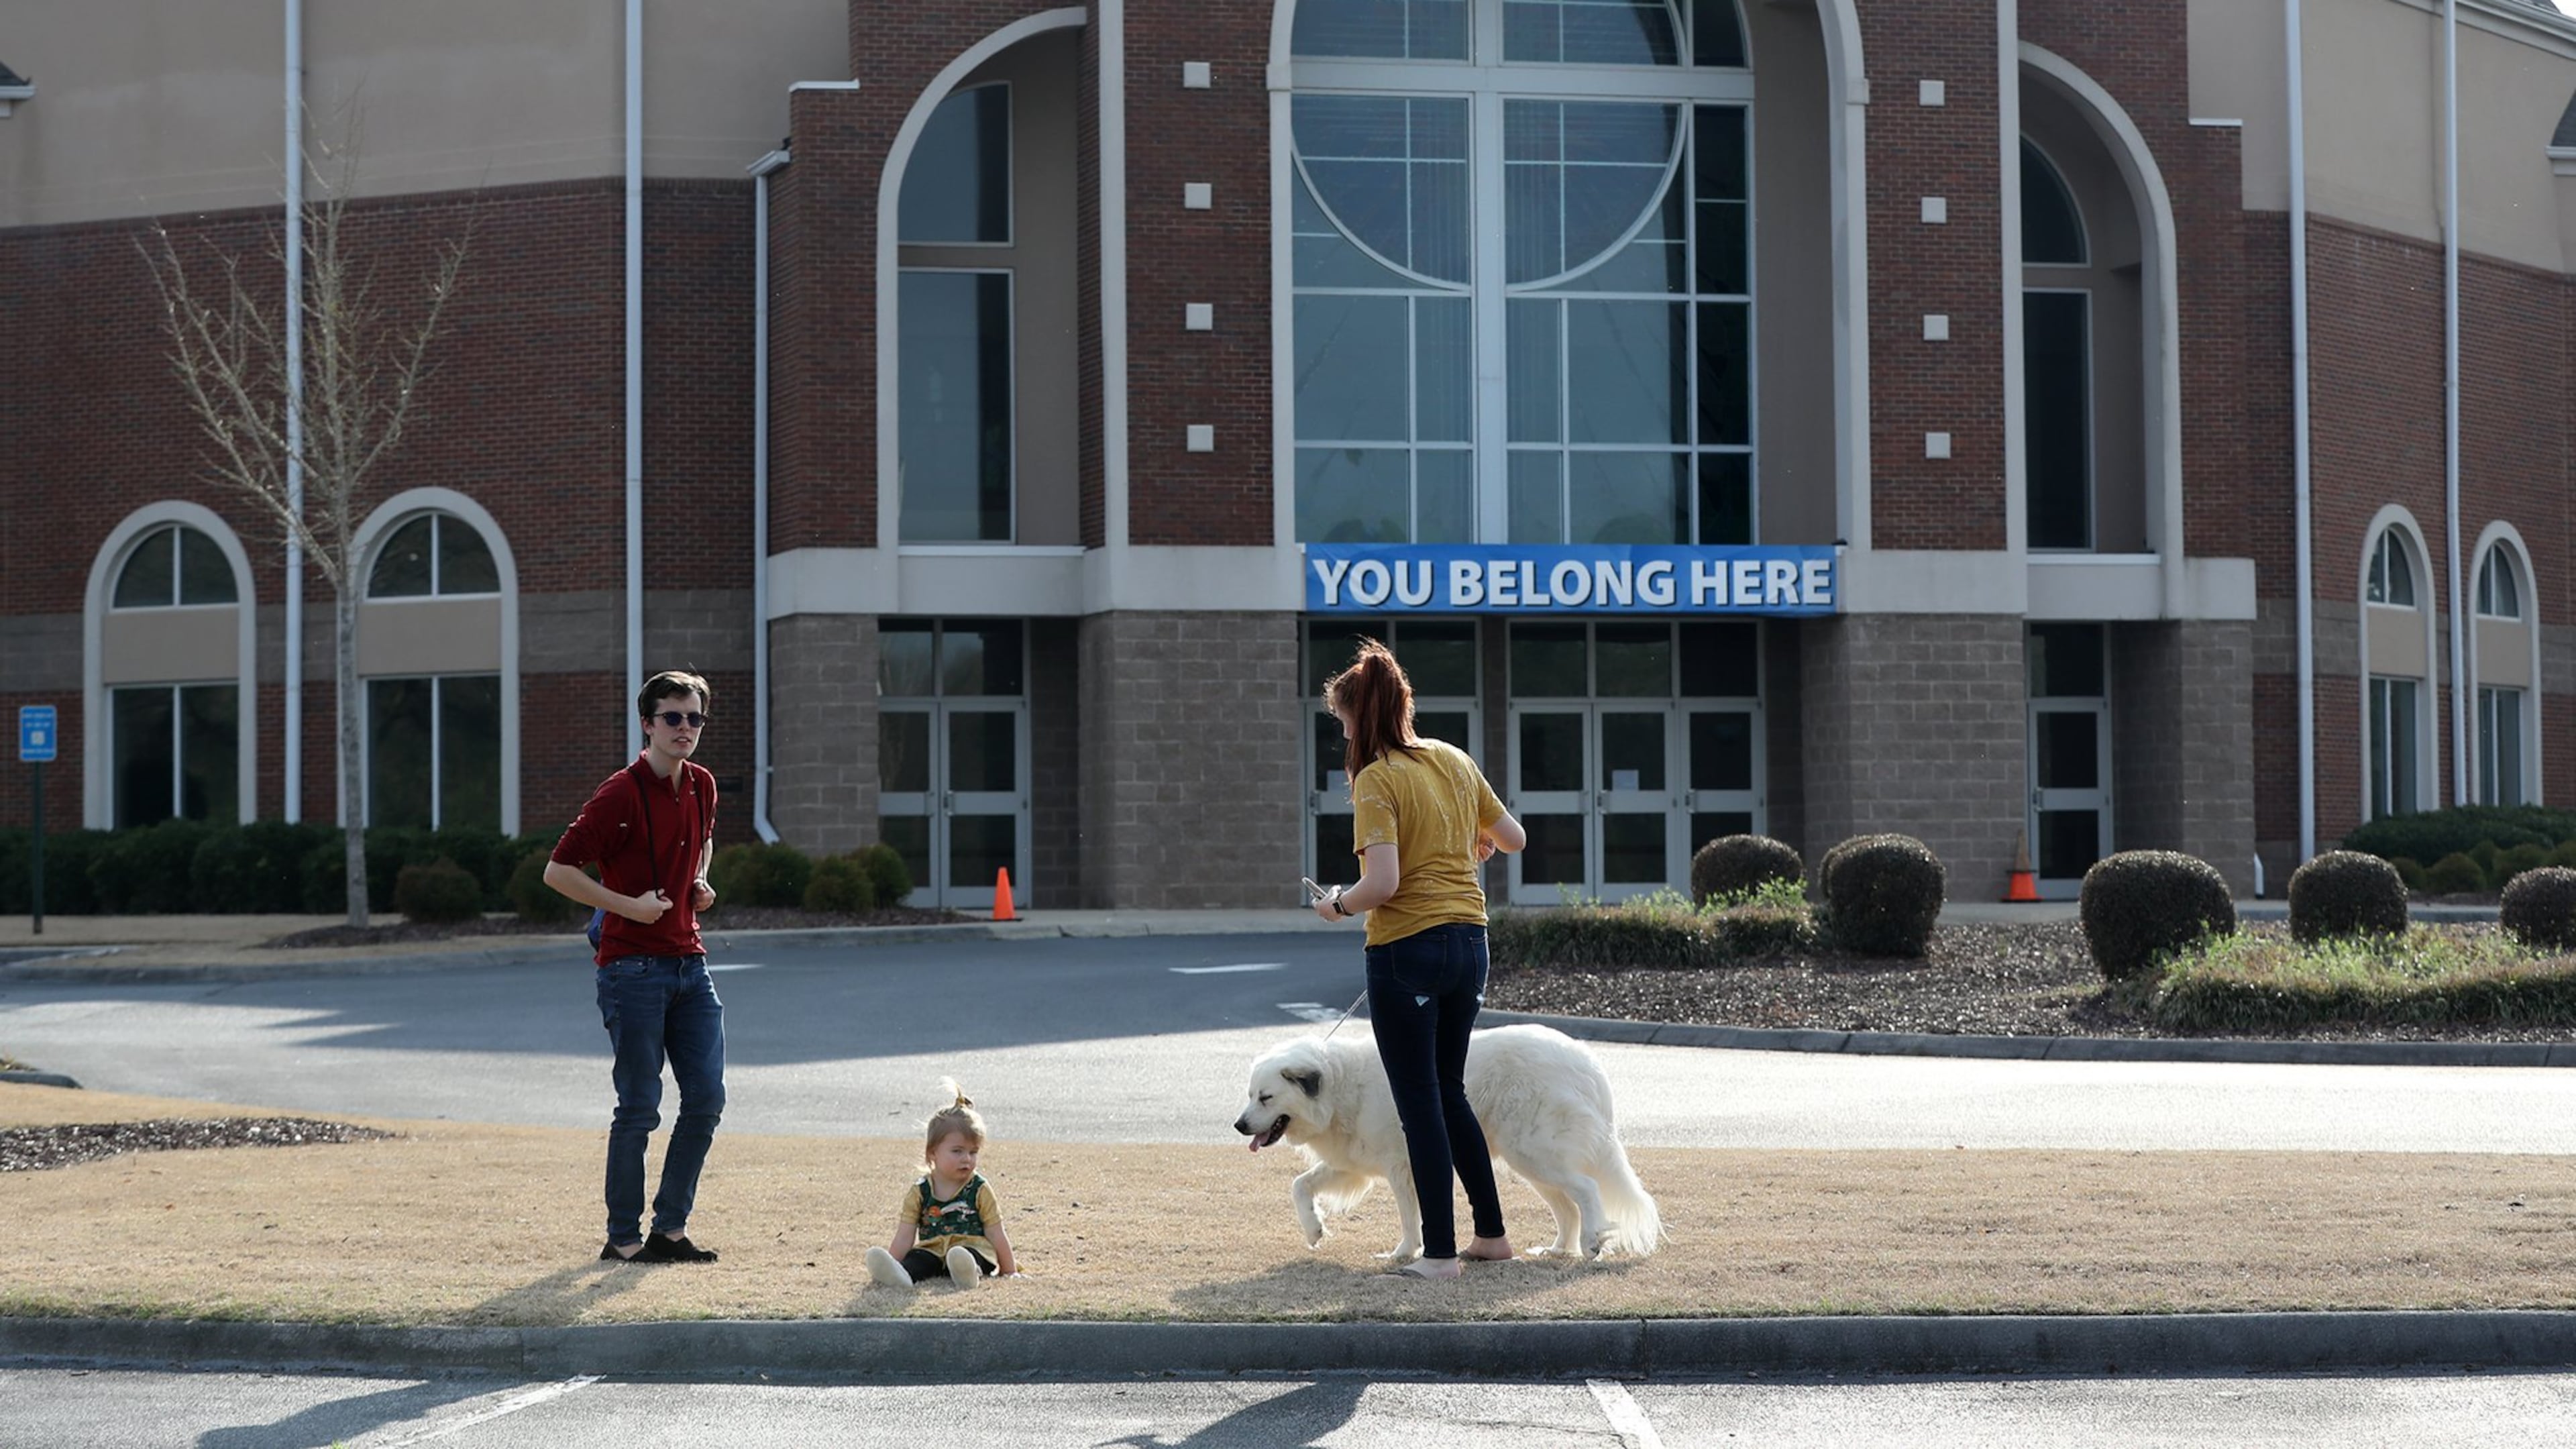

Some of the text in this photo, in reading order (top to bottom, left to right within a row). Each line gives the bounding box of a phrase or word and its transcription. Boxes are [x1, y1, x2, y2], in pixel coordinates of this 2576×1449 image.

[1313, 559, 1833, 606] YOU BELONG HERE
